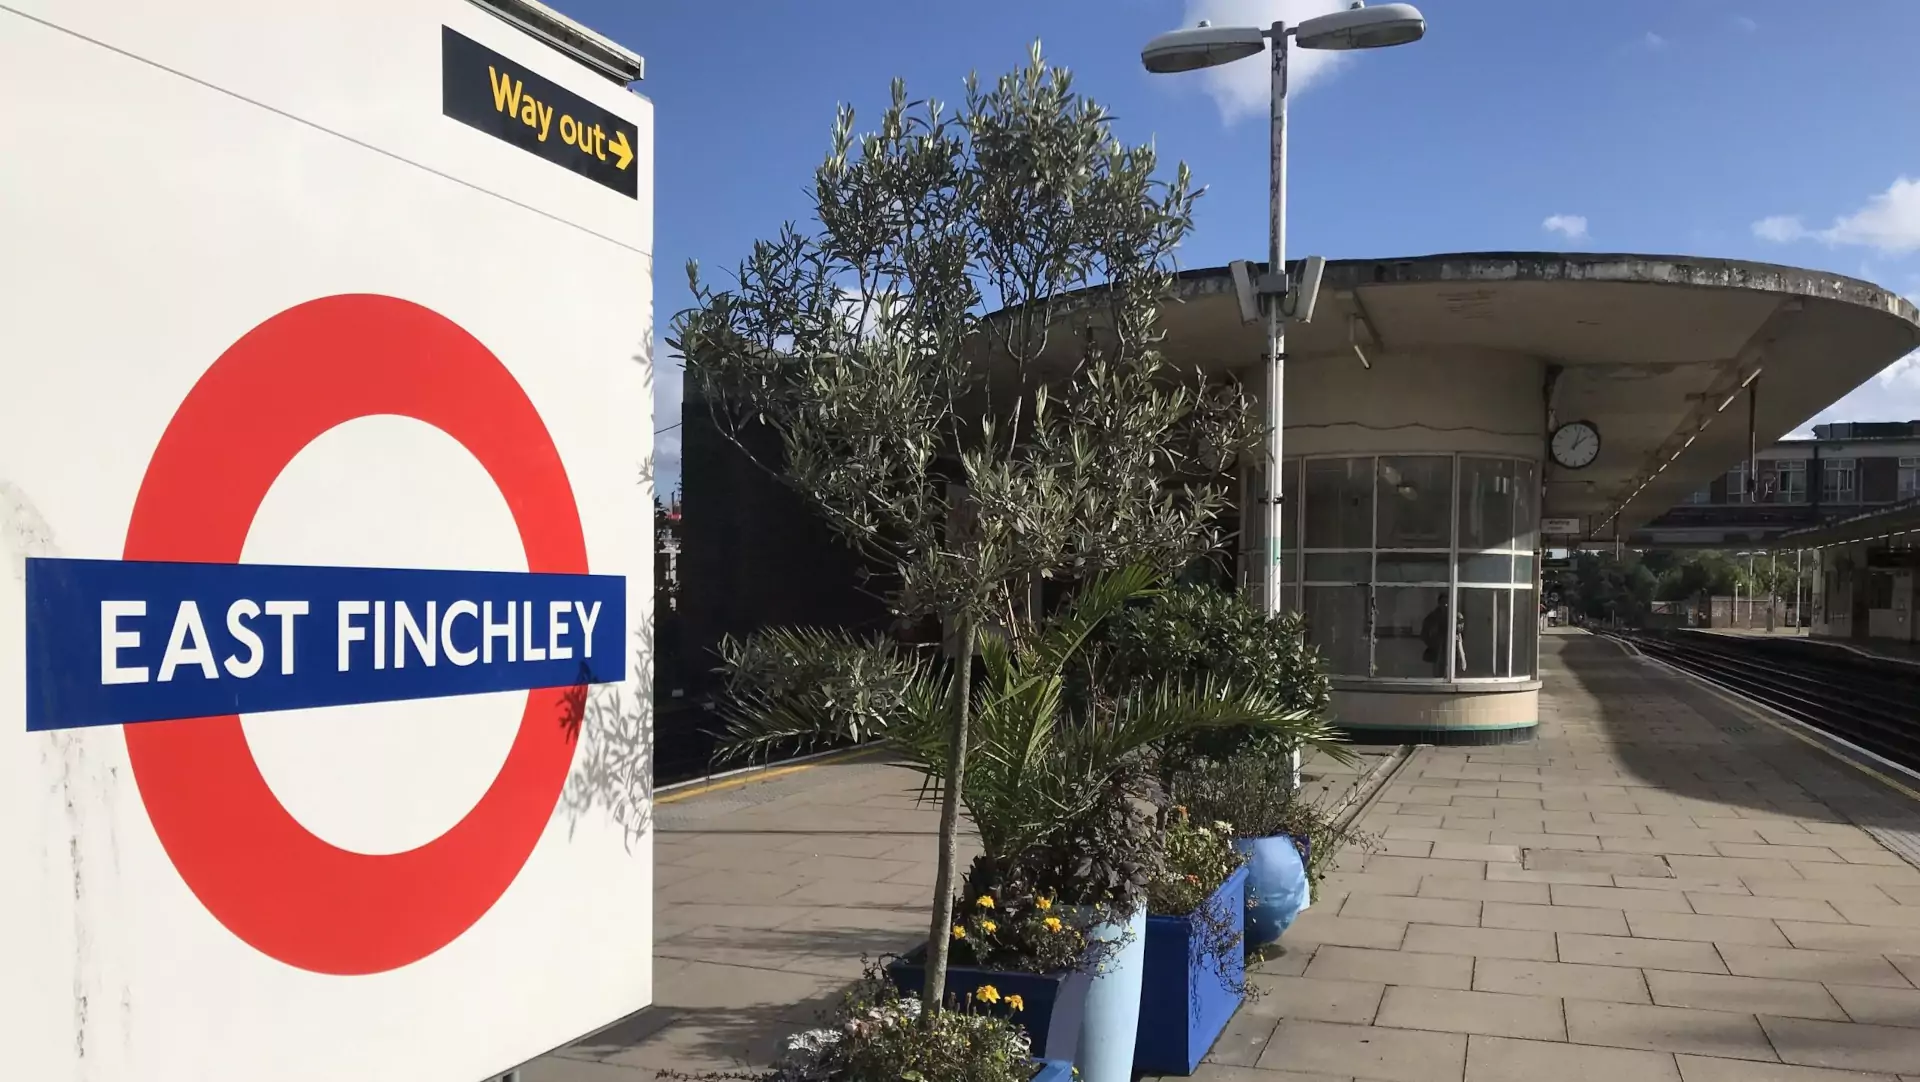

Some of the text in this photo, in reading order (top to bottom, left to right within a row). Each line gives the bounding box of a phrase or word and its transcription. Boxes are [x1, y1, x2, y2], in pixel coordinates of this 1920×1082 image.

[489, 65, 606, 161] Way out
[100, 599, 602, 685] EAST FINCHLEY
